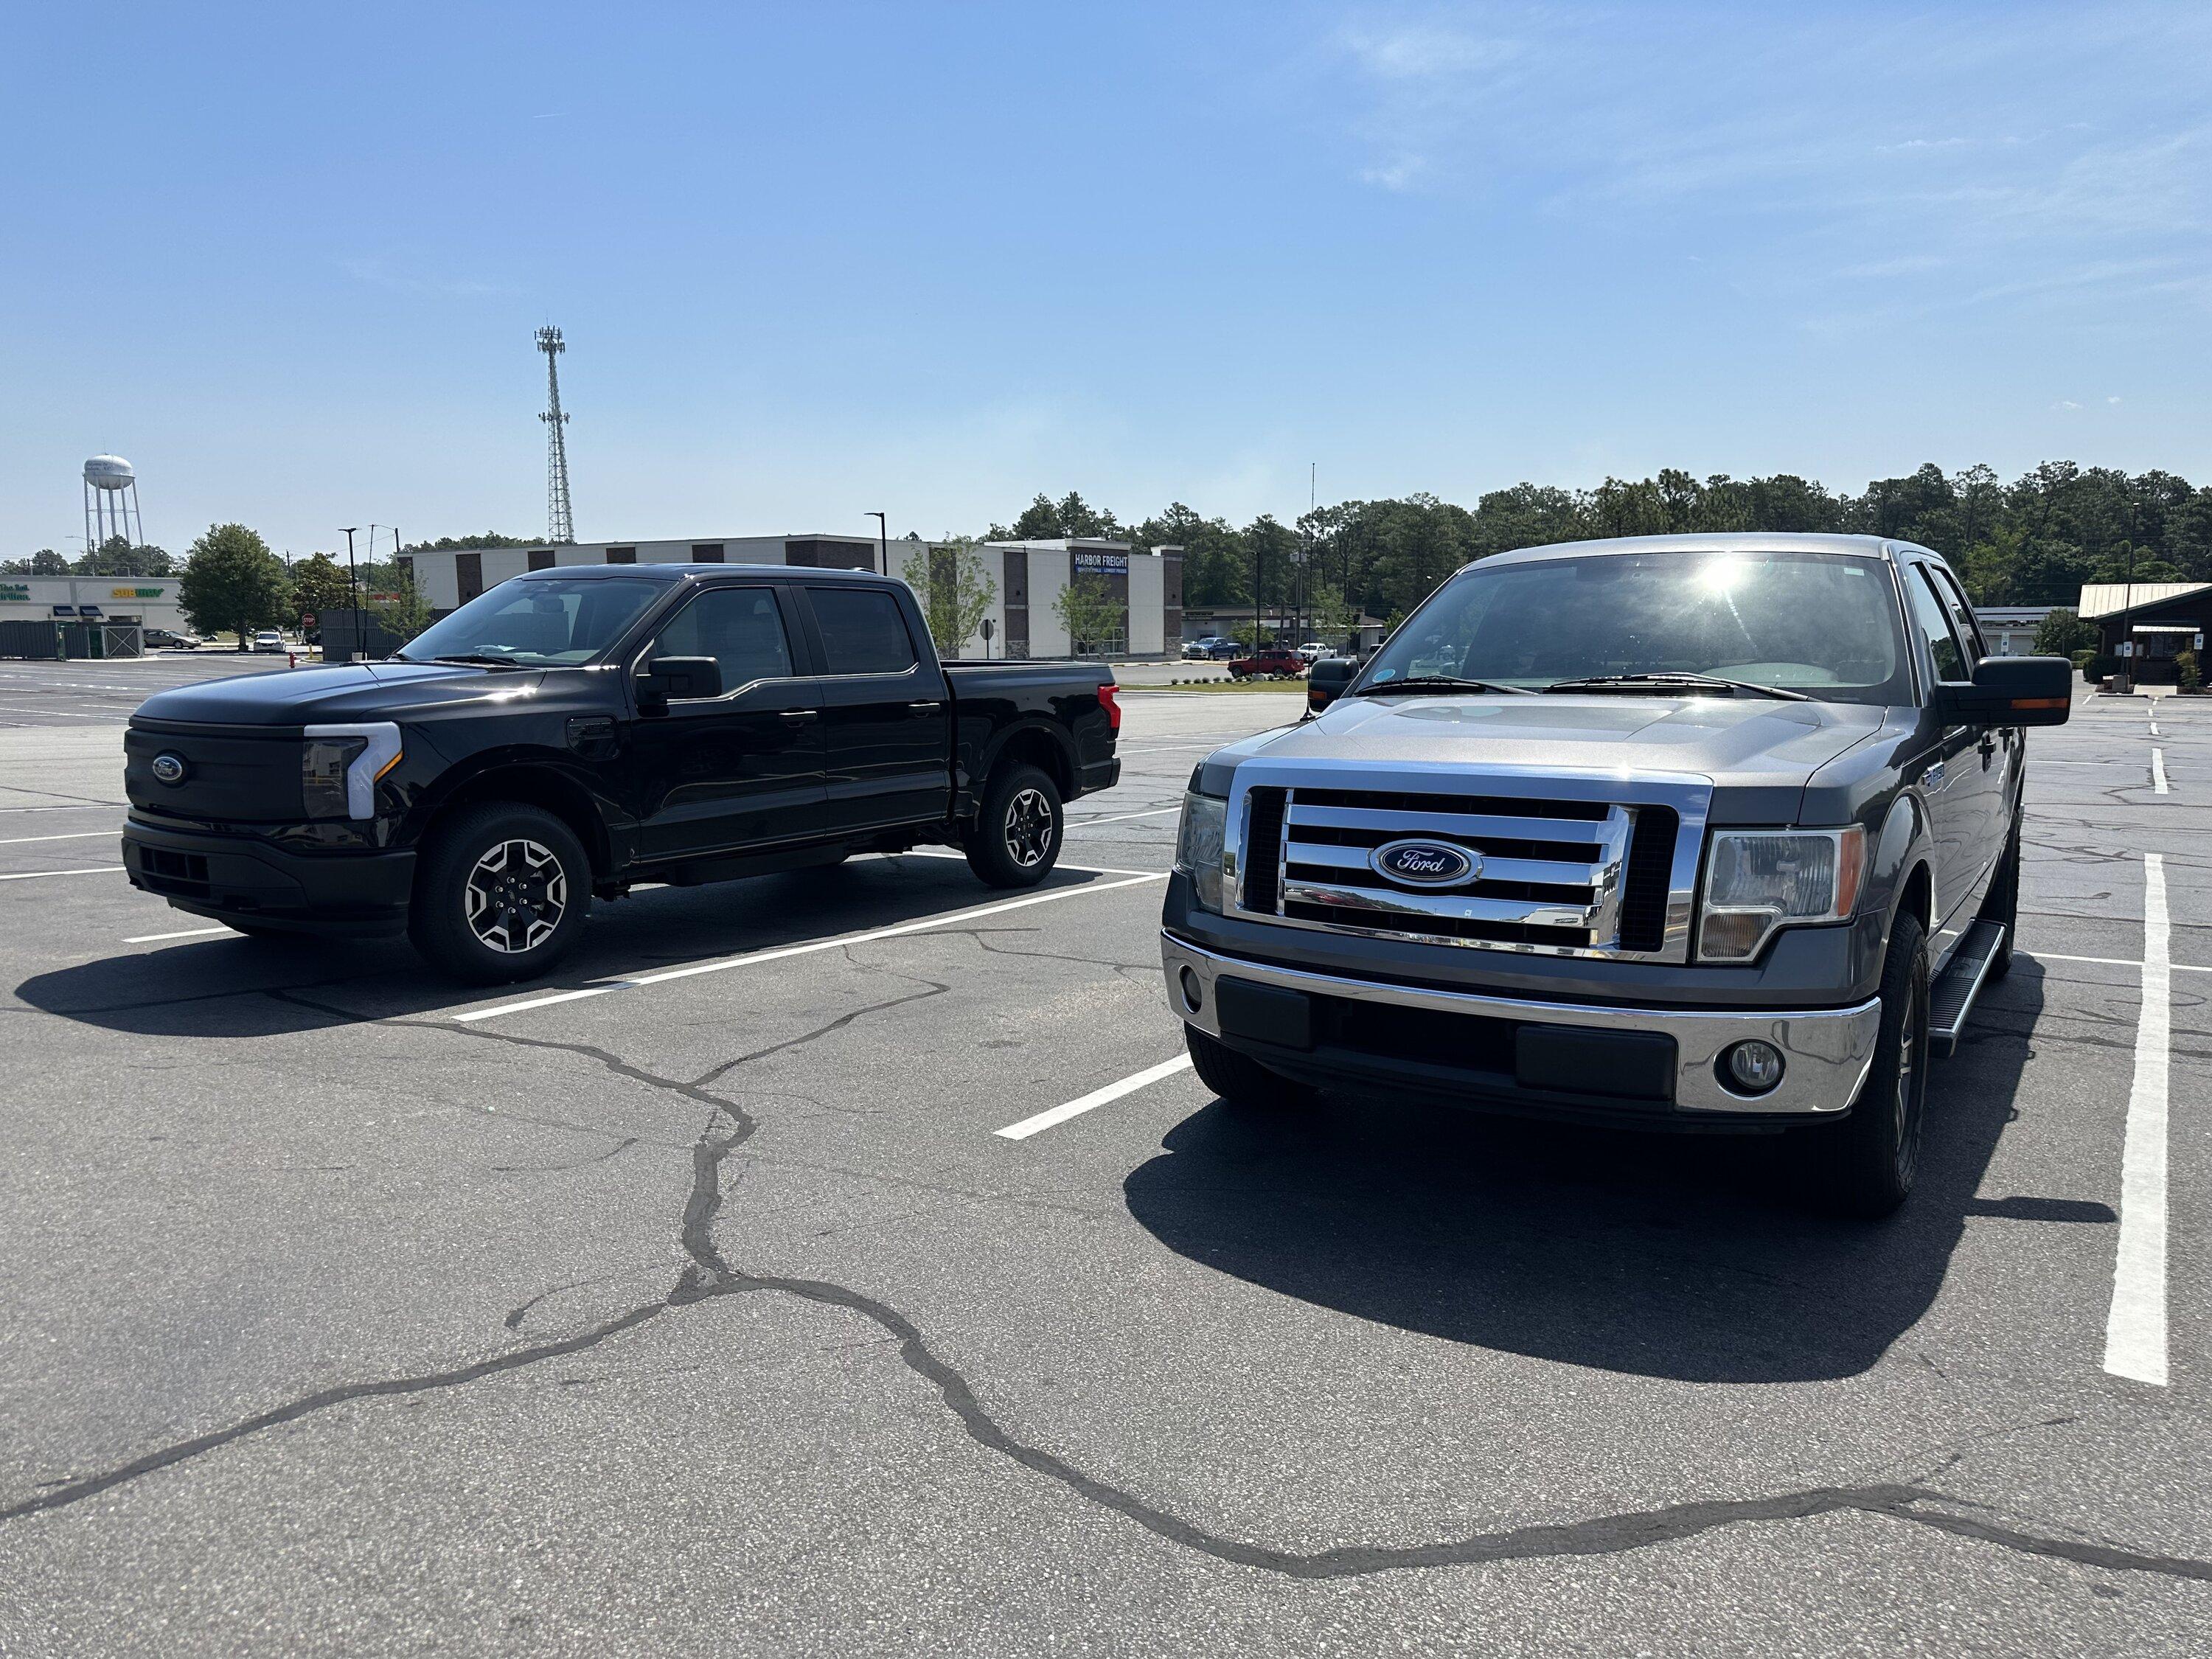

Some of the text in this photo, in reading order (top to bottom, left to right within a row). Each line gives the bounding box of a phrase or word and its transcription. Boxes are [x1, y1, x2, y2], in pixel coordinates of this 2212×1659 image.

[1075, 554, 1128, 567] HARBOR FREIGHT
[112, 588, 165, 598] SUBWAY
[157, 761, 175, 775] Ford
[1397, 849, 1446, 872] Ford
